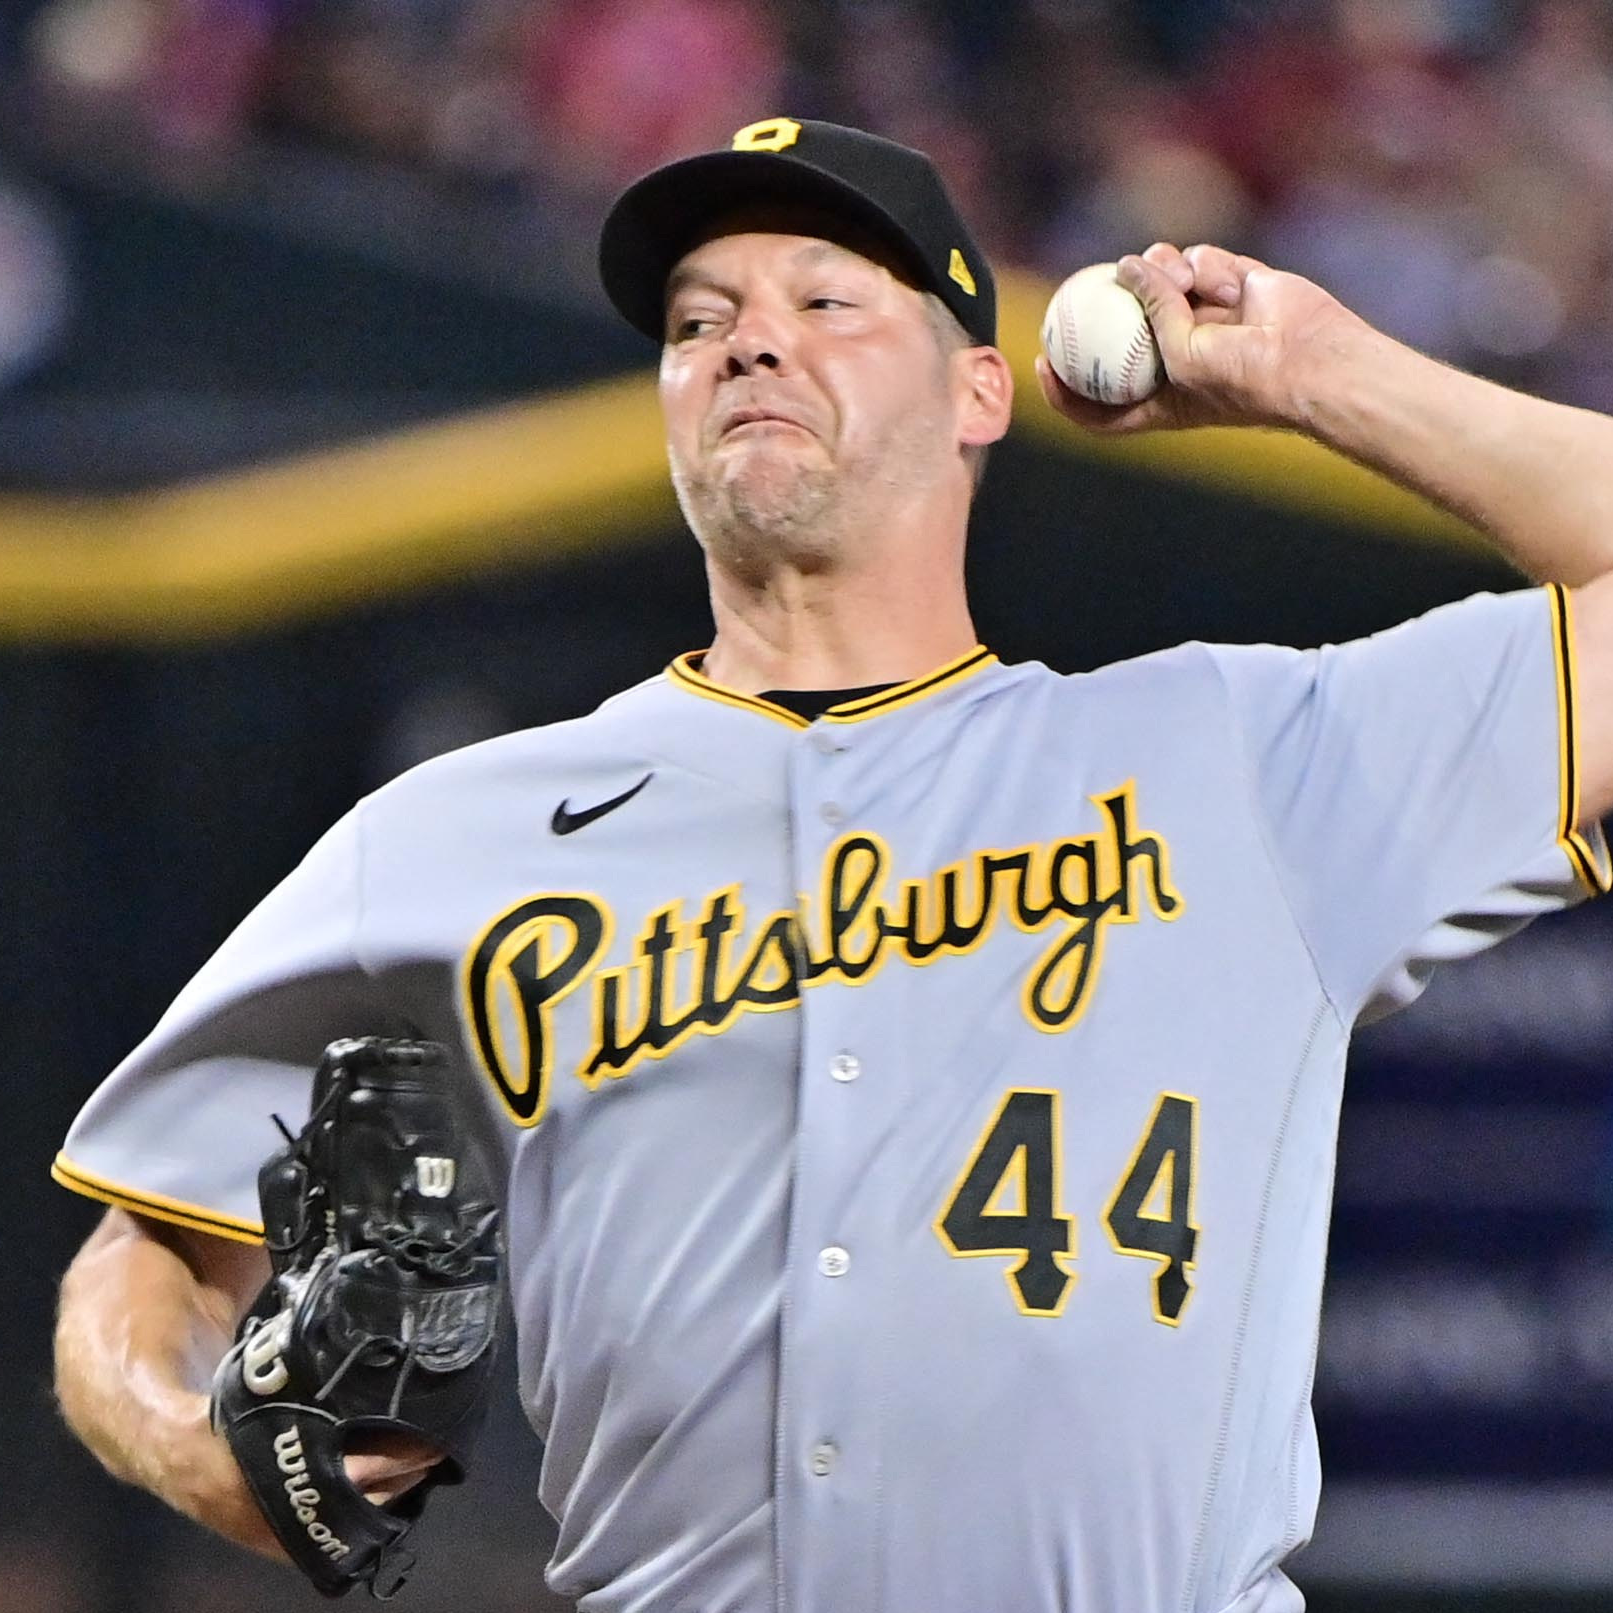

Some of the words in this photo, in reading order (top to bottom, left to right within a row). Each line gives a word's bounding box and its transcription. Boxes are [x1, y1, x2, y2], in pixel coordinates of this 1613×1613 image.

[462, 779, 1185, 1127] Pittsburgh
[932, 1087, 1201, 1327] 44
[273, 1424, 350, 1561] Wilson
